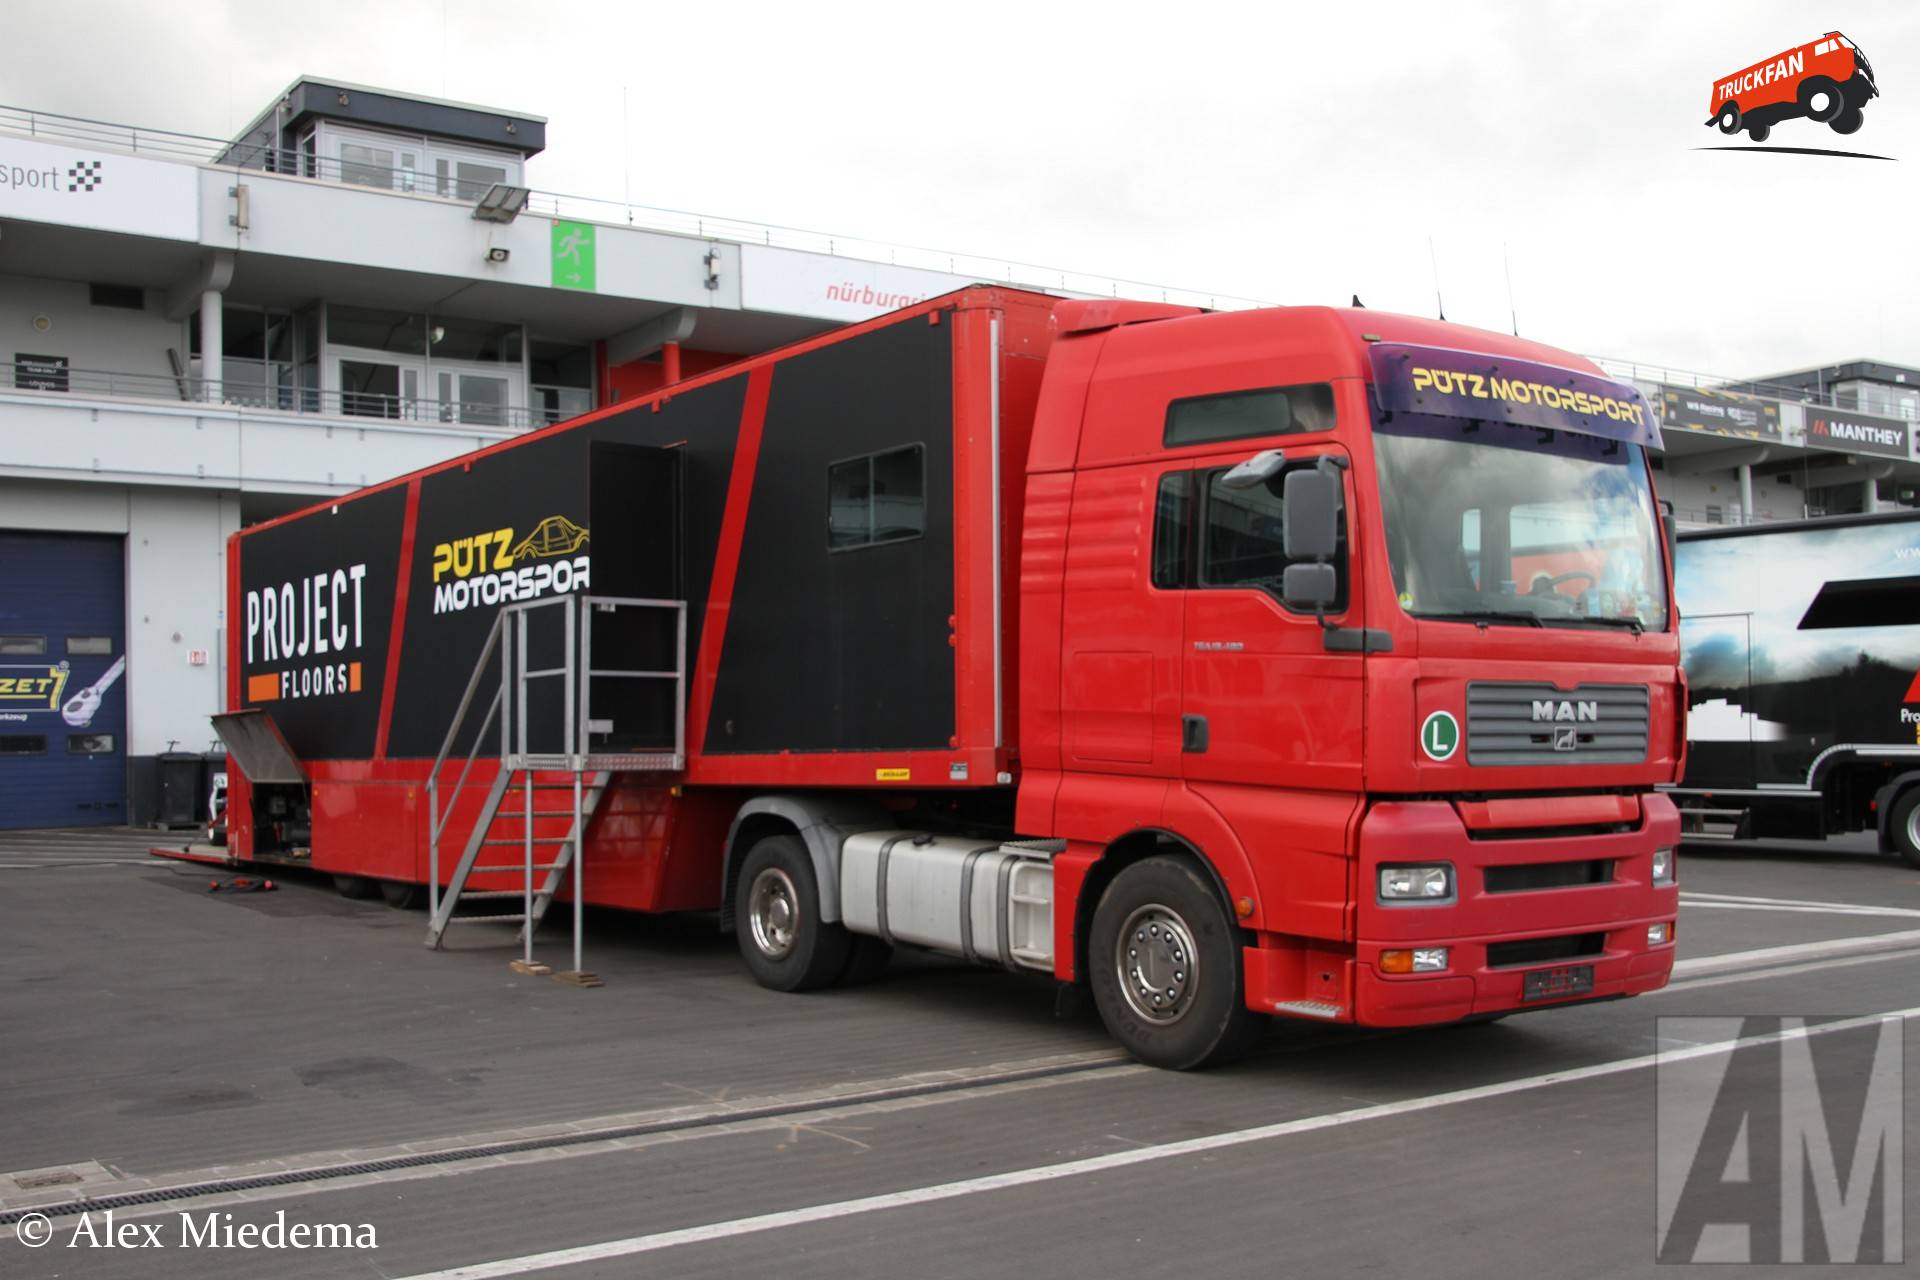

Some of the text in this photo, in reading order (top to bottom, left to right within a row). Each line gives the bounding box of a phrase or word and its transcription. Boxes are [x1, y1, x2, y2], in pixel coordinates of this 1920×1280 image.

[1411, 367, 1645, 426] PÜTZ MOTORSPORT
[1830, 421, 1903, 446] MANTHEY
[432, 527, 515, 584] PÜTZ
[433, 556, 590, 615] MOTORSPOR
[247, 563, 367, 664] PROJECT
[281, 663, 348, 699] FLOORS
[1532, 700, 1598, 721] MAN
[1432, 720, 1449, 751] L
